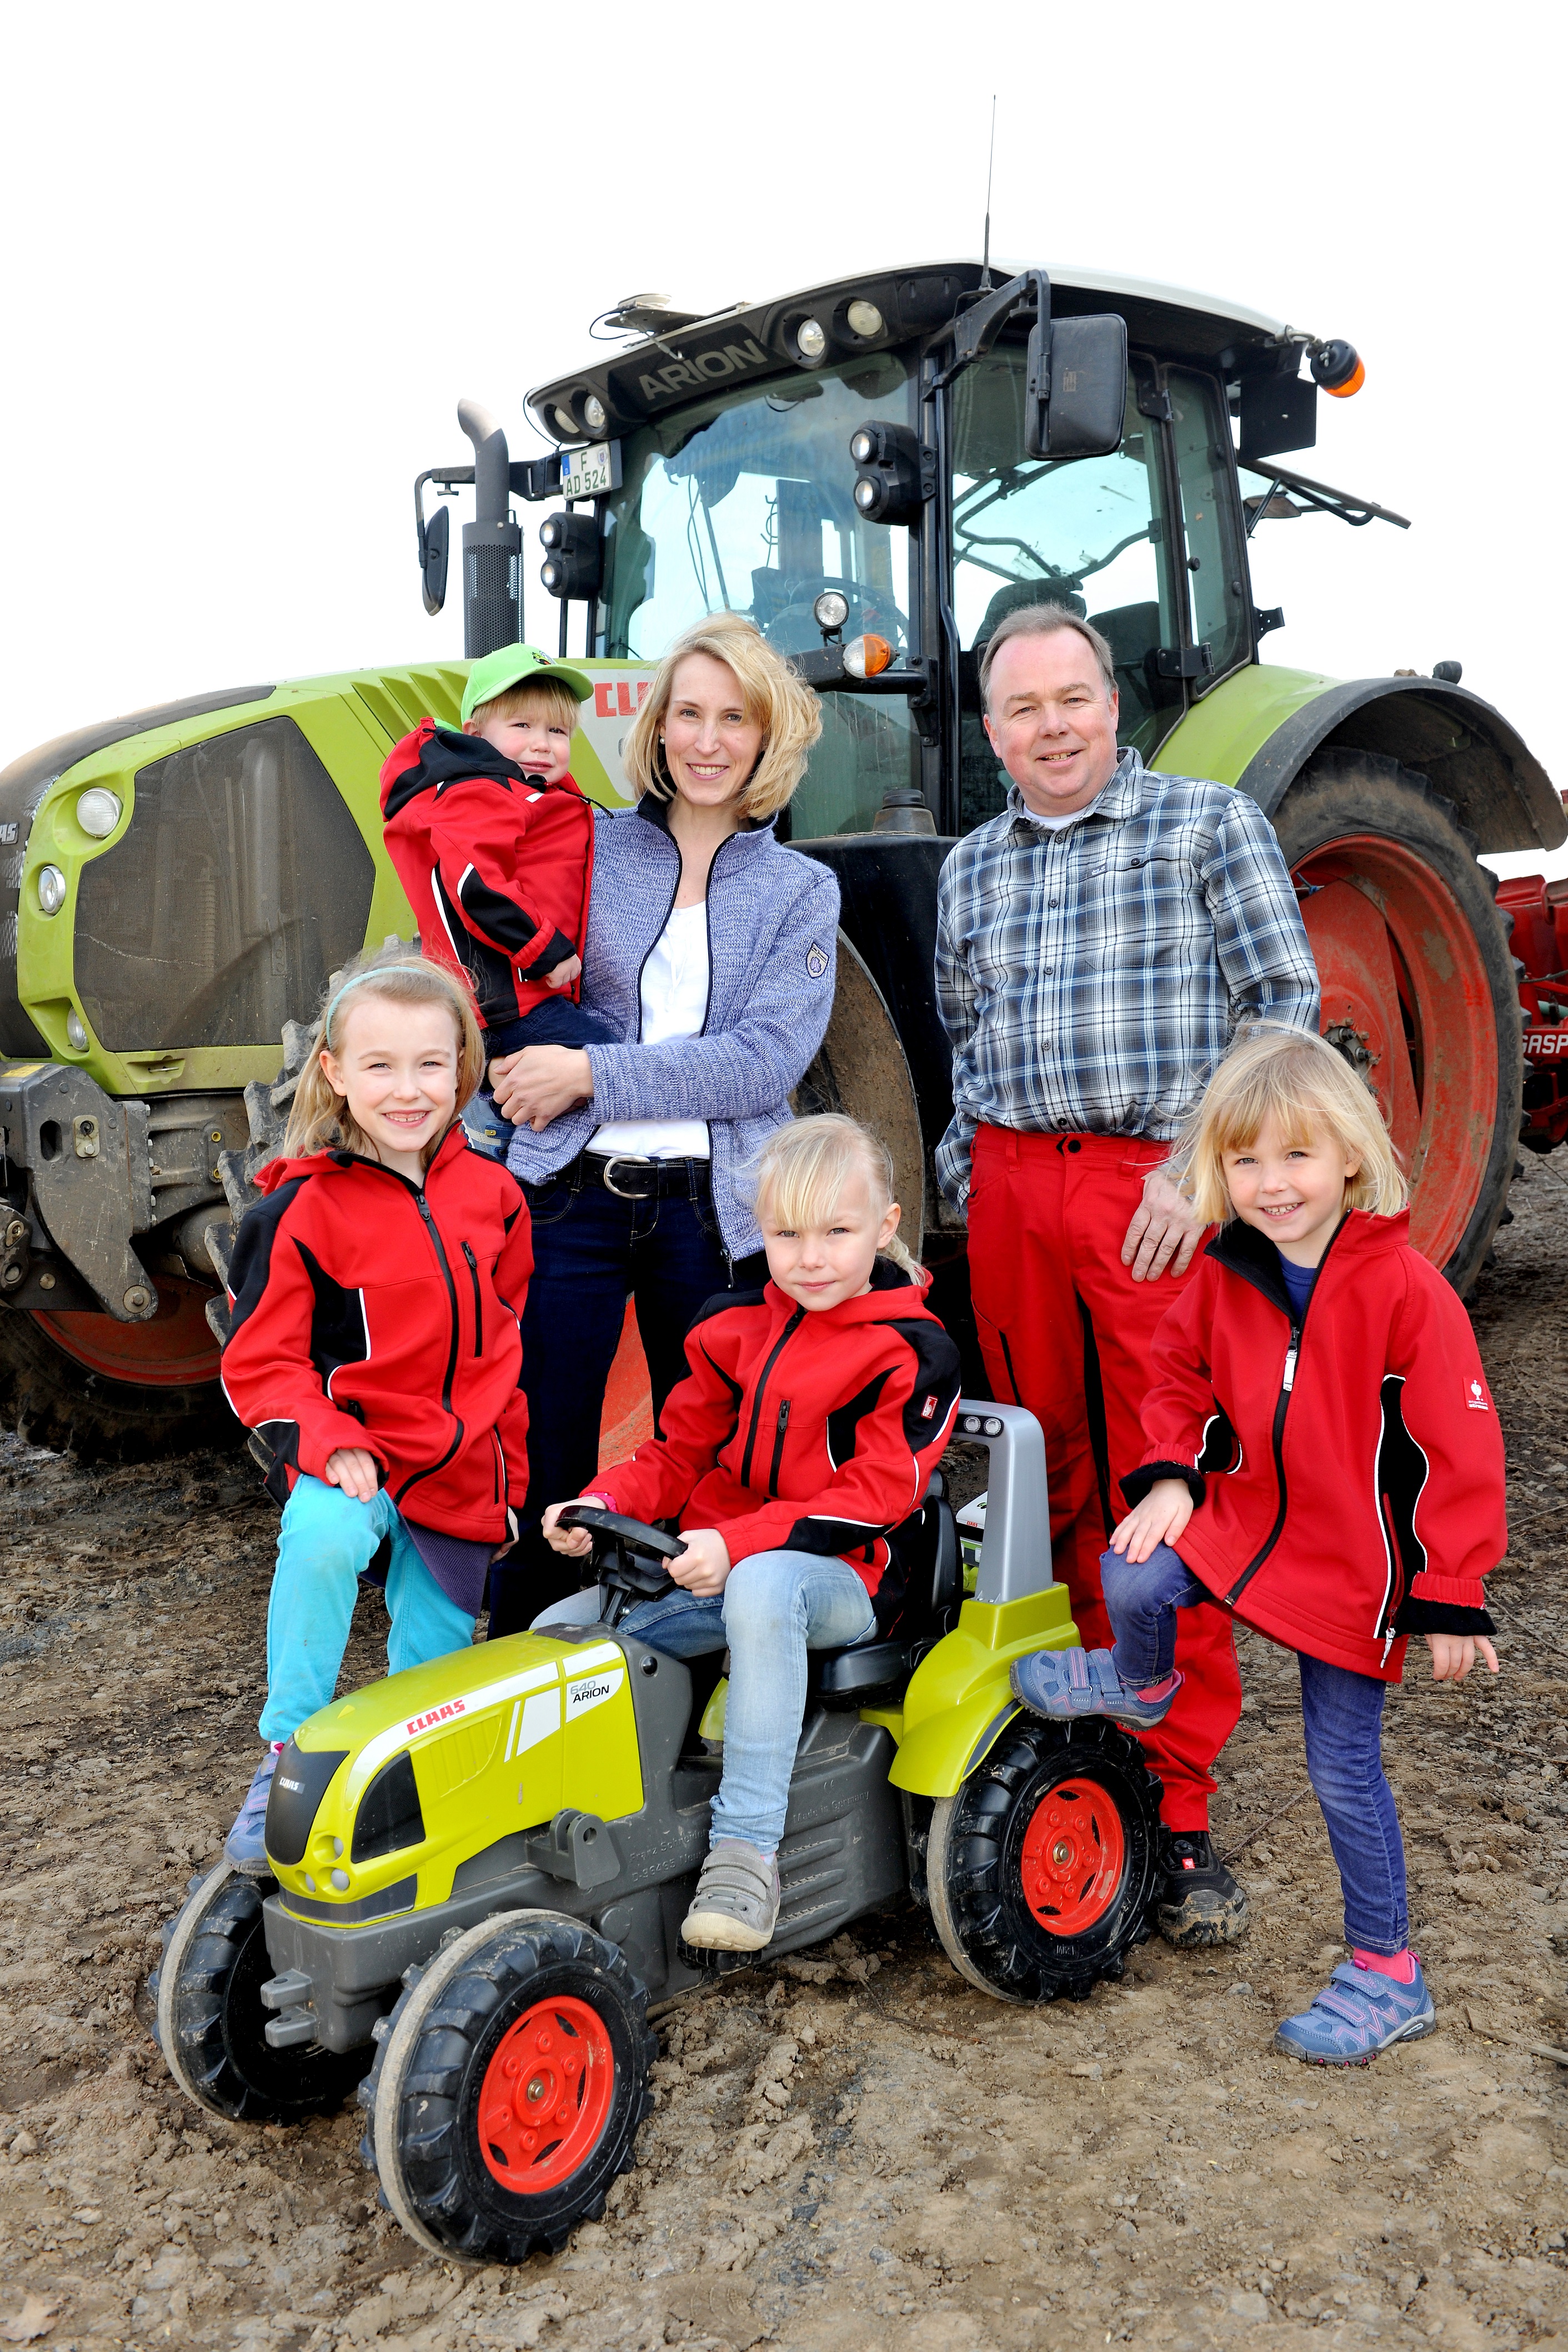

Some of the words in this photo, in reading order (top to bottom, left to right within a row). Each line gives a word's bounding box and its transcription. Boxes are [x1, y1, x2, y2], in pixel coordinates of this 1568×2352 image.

[639, 338, 768, 401] ARION
[580, 451, 587, 471] F
[567, 474, 580, 496] AD
[584, 467, 607, 491] 524
[570, 1680, 596, 1695] 640
[573, 1685, 610, 1704] ARION
[407, 1699, 466, 1735] CLAAS
[831, 1790, 870, 1810] Germany
